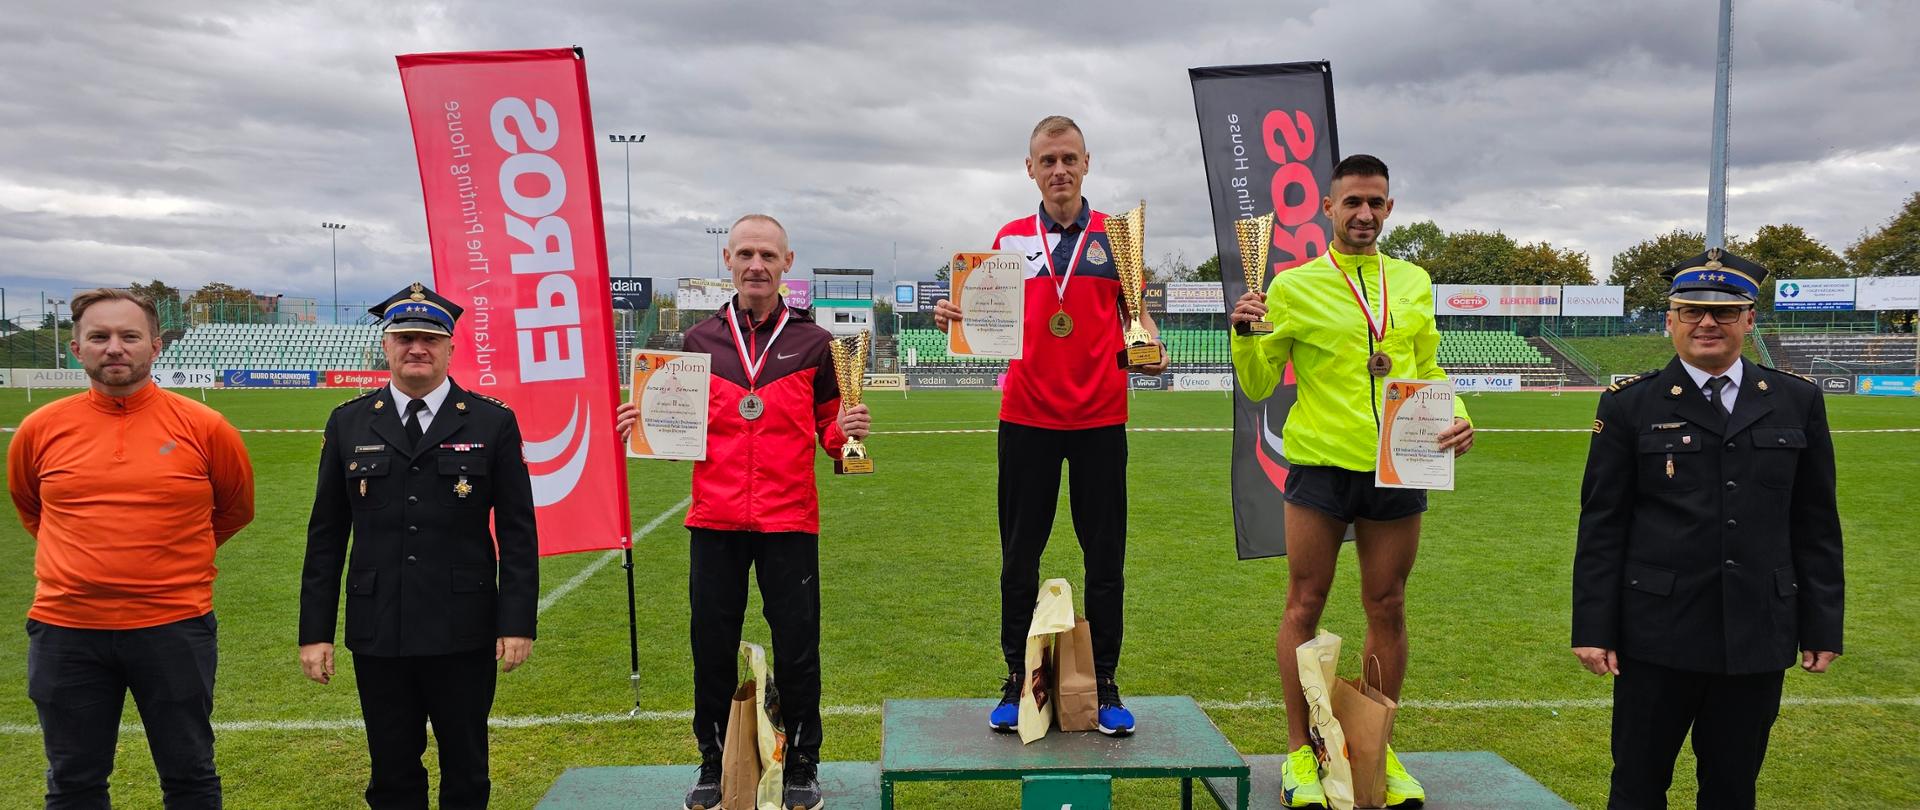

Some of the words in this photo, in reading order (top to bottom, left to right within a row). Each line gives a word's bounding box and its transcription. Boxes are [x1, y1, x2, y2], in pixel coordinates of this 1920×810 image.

[972, 256, 1020, 273] Dyplom
[1567, 297, 1620, 305] ROSSMANN
[655, 357, 705, 374] Dyplom
[34, 371, 88, 381] ALDRE
[189, 374, 212, 384] IPS
[345, 375, 373, 385] Energa
[1484, 377, 1513, 387] WOLF
[1405, 385, 1451, 403] Dyplom
